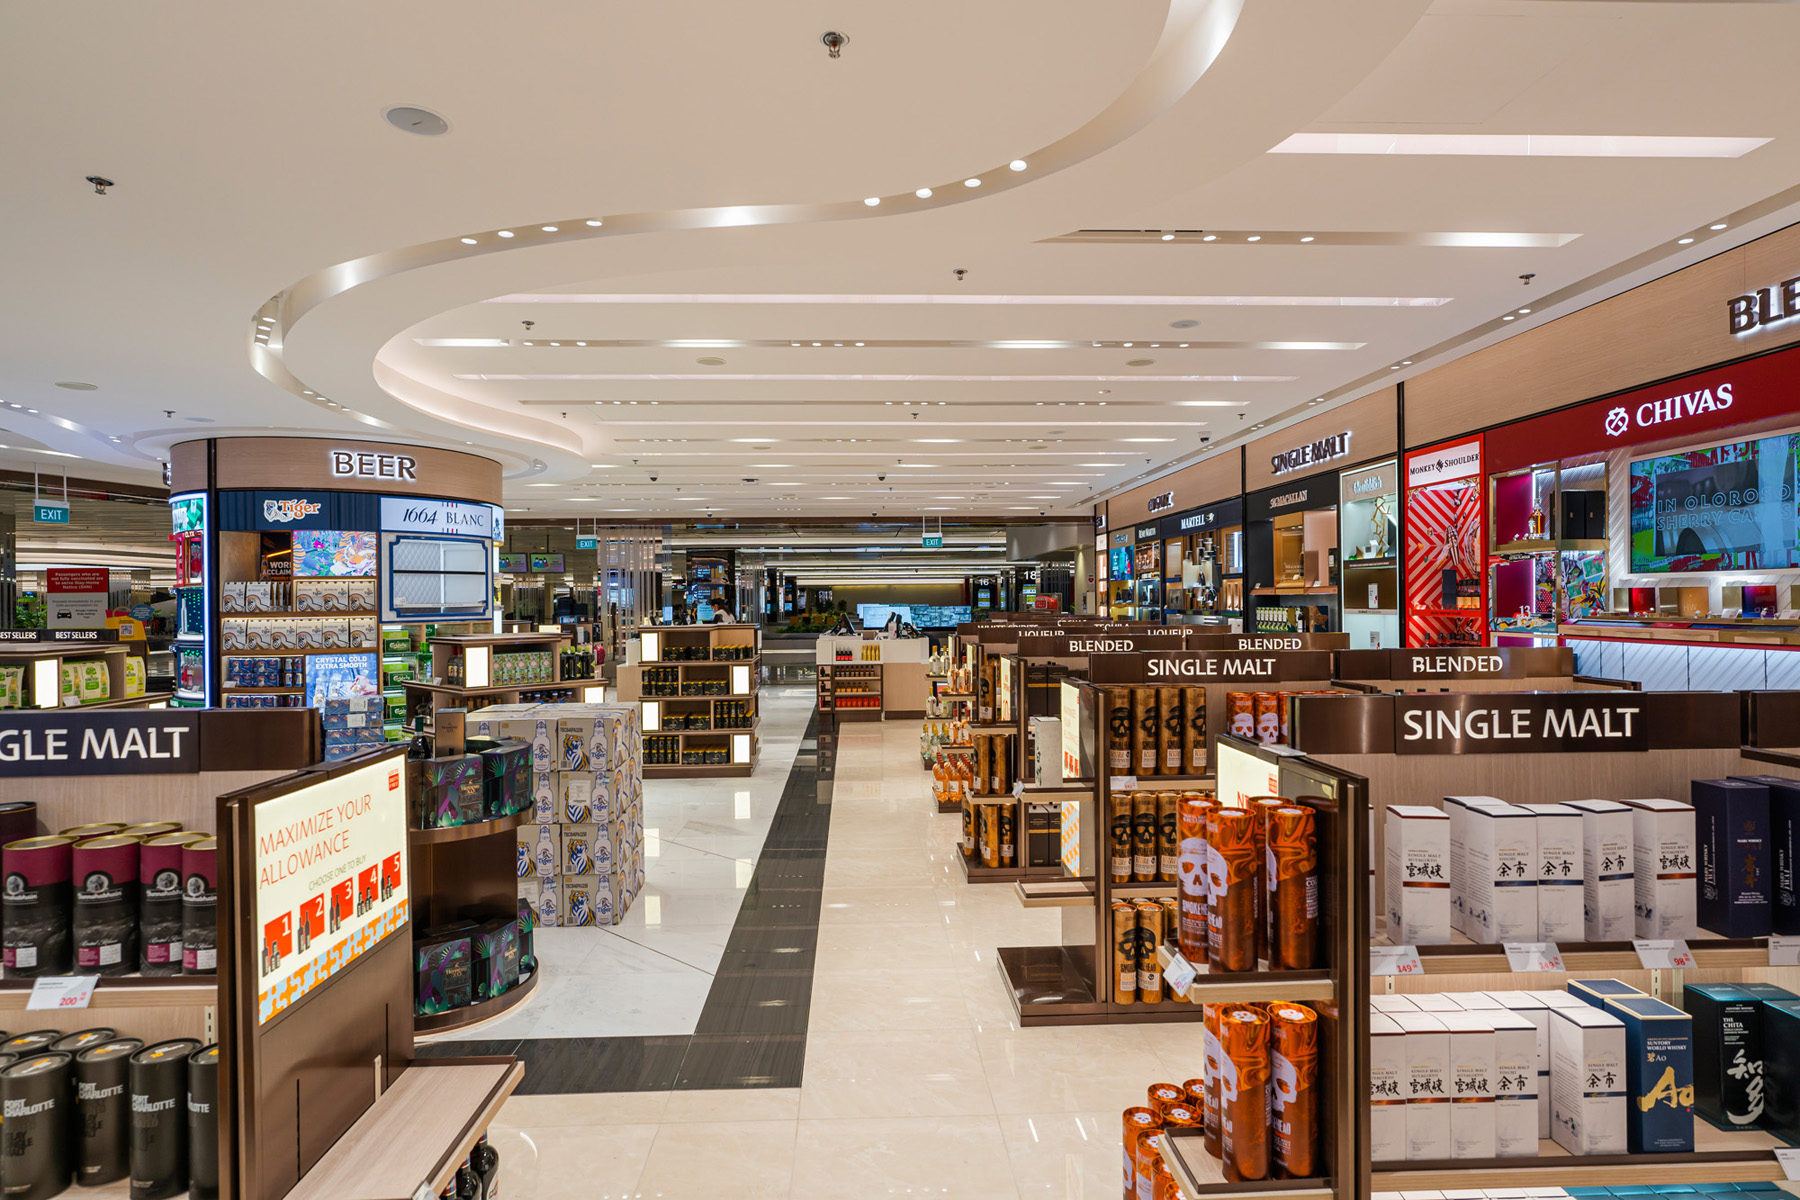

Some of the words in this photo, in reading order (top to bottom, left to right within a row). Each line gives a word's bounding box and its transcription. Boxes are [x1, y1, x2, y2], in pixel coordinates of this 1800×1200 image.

[1636, 383, 1733, 427] CHIVAS
[1271, 445, 1311, 474] SINGLE
[1311, 432, 1348, 462] MALT
[333, 451, 417, 480] BEER
[1410, 461, 1436, 476] MONKEY
[1444, 451, 1480, 468] SHOULDER
[280, 499, 321, 519] Tiger
[1657, 498, 1677, 513] IN
[41, 508, 62, 521] EXIT
[402, 506, 438, 525] 1664
[446, 511, 484, 527] BLANC
[1181, 514, 1206, 530] MARTELL
[1656, 510, 1723, 531] SHERRY
[579, 539, 594, 548] EXIT
[926, 538, 939, 546] EXIT
[1023, 570, 1037, 580] 18
[1518, 605, 1531, 620] 13
[12, 631, 37, 639] SELLERS
[55, 631, 71, 639] BEST
[71, 631, 98, 639] SELLERS
[1069, 639, 1134, 652] BLENDED
[1238, 638, 1302, 650] BLENDED
[315, 656, 347, 664] CRYSTAL
[1147, 658, 1218, 676] SINGLE
[1222, 658, 1277, 675] MALT
[1411, 654, 1504, 673] BLENDED
[1403, 708, 1532, 741] SINGLE
[1542, 707, 1640, 739] MALT
[0, 728, 69, 762] GLE
[80, 727, 190, 760] MALT
[534, 753, 549, 761] Tiger
[537, 805, 551, 813] Tiger
[259, 808, 334, 858] MAXIMIZE
[337, 794, 372, 823] YOUR
[259, 830, 350, 890] ALLOWANCE
[393, 855, 400, 872] 5
[538, 857, 552, 865] Tiger
[308, 871, 334, 891] CHOOSE
[334, 864, 347, 878] ONE
[347, 859, 355, 869] TO
[355, 853, 367, 867] BUY
[370, 868, 377, 884] 4
[344, 881, 353, 899] 3
[315, 897, 323, 917] 2
[541, 908, 555, 916] Tiger
[281, 915, 291, 937] 1
[1396, 964, 1413, 973] 149
[1539, 961, 1555, 970] 149
[1673, 957, 1686, 966] 98
[59, 997, 78, 1007] 200
[79, 1082, 97, 1091] PORT
[79, 1084, 124, 1100] CHARLOTTE
[1637, 1066, 1694, 1112] Ao
[4, 1099, 26, 1108] PORT
[132, 1094, 149, 1103] PORT
[132, 1098, 176, 1113] CHARLOTTE
[4, 1098, 55, 1117] CHARLOTTE
